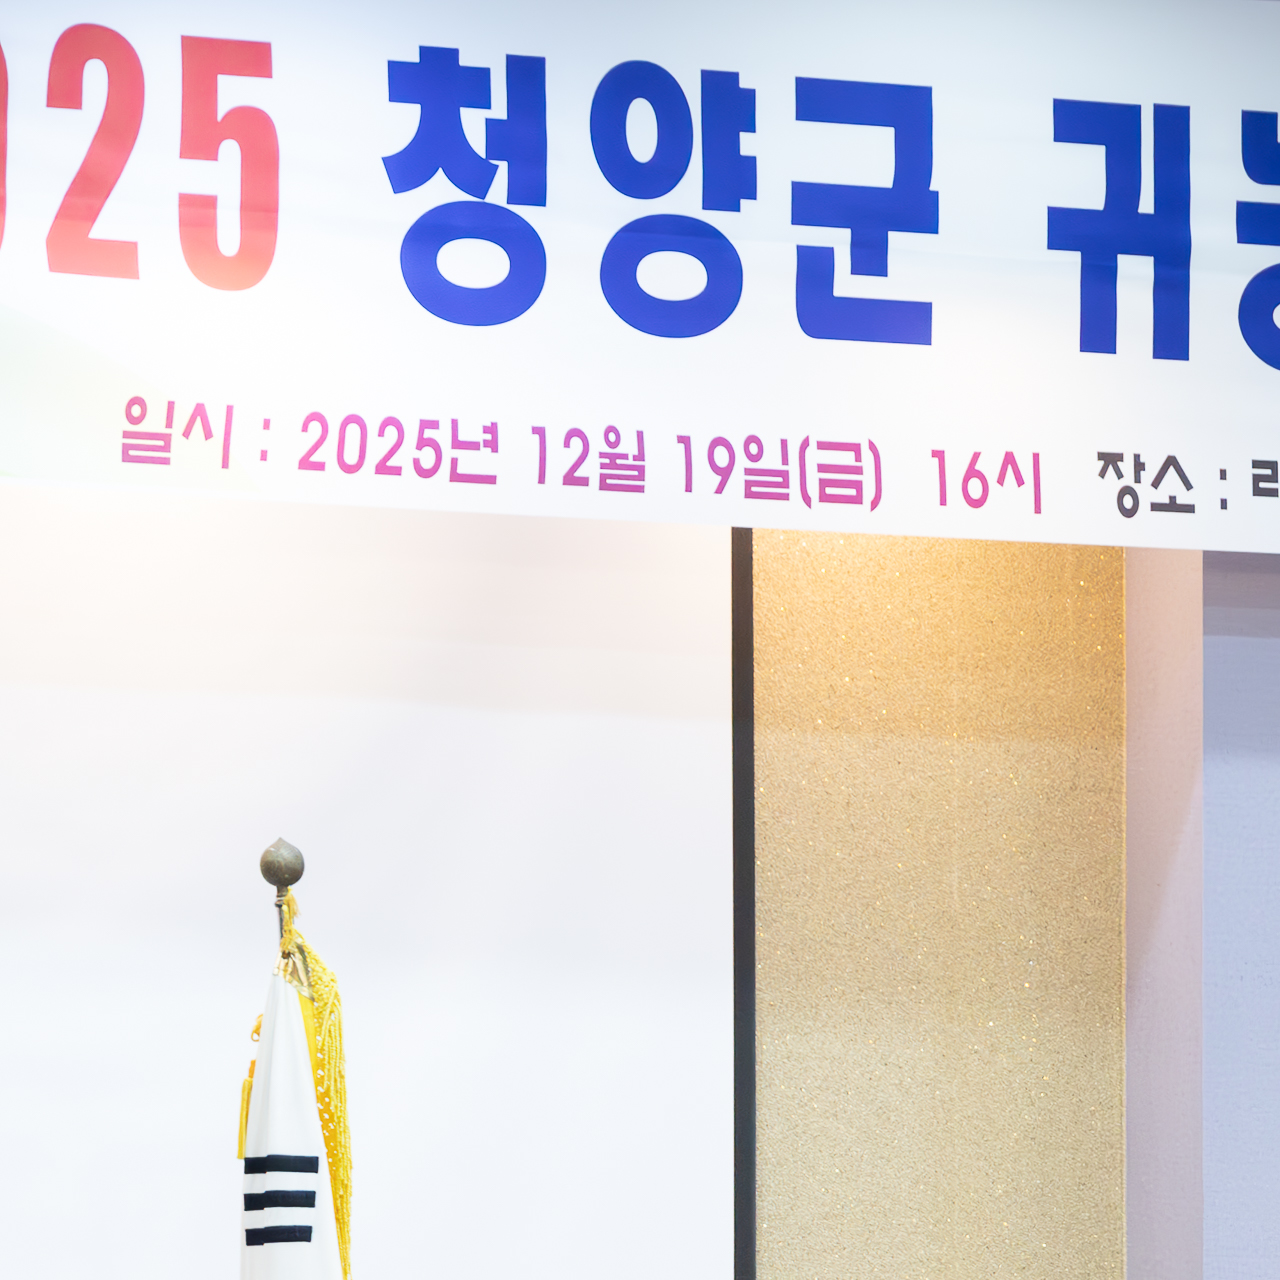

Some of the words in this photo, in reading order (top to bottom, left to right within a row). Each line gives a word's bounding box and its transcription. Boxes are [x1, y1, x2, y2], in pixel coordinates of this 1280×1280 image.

[0, 22, 280, 292] 25
[382, 45, 939, 346] 청양군
[121, 396, 233, 470] 일시
[297, 412, 499, 486] 2025년
[531, 425, 646, 494] 12월
[677, 435, 882, 512] 19일(금)
[931, 449, 1043, 515] 16시
[1097, 451, 1196, 519] 장소
